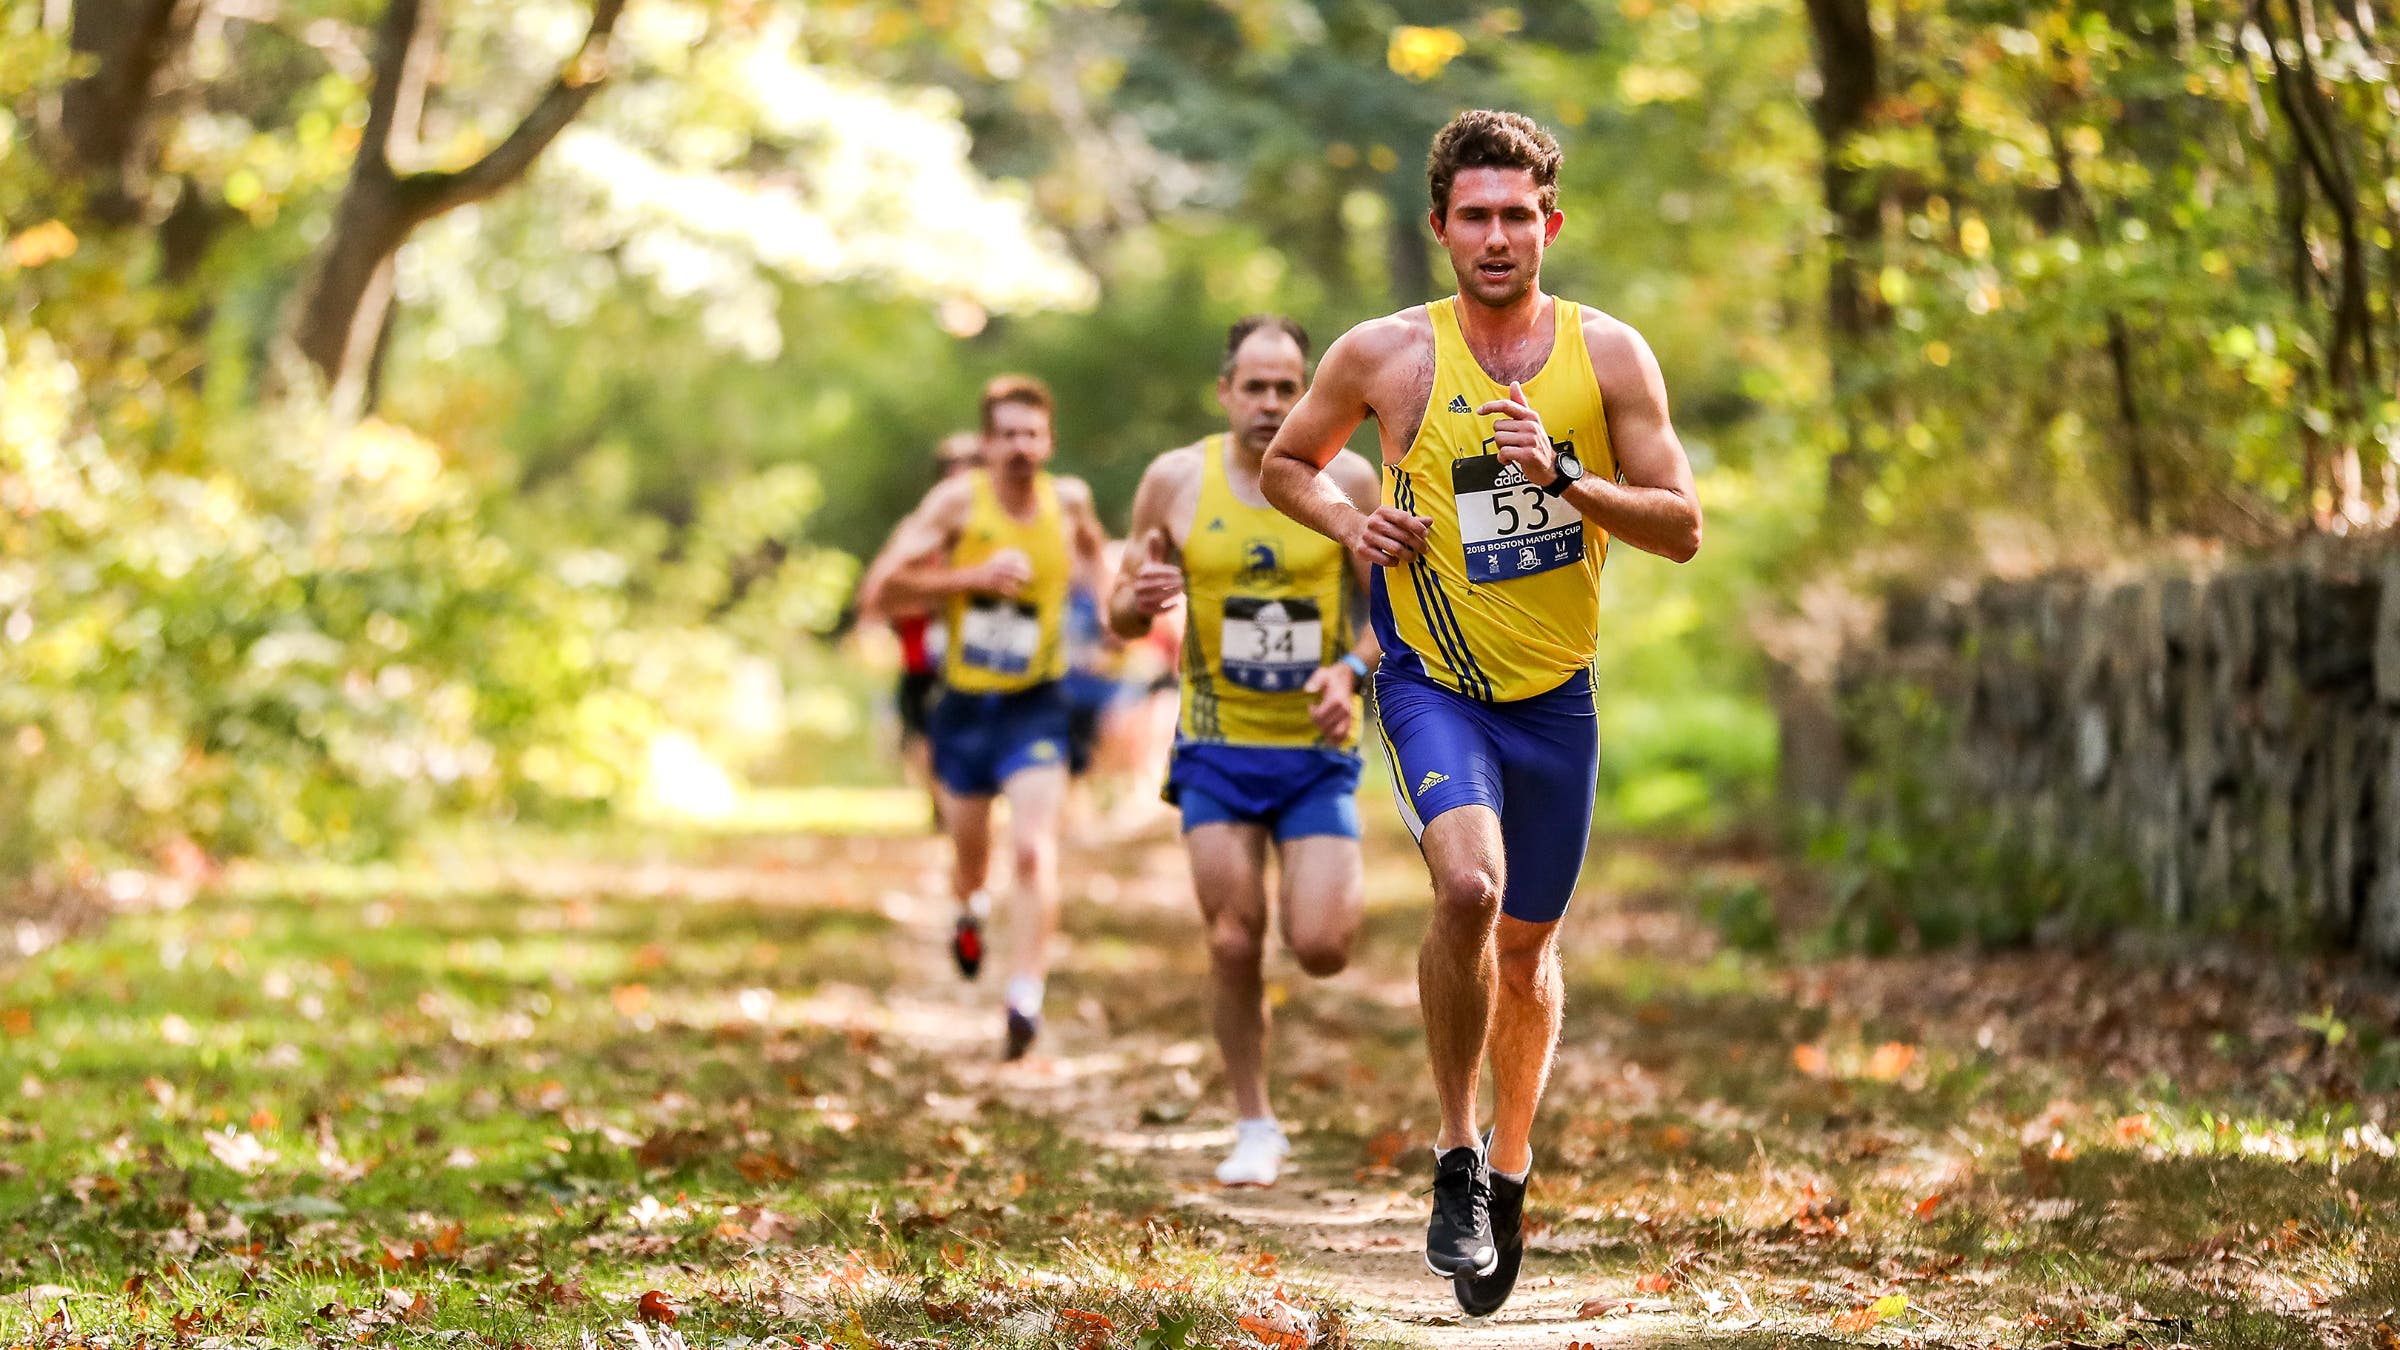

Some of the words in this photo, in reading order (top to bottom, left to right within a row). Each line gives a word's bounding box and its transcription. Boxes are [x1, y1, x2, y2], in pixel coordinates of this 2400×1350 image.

[1492, 486, 1549, 536] 53
[1466, 545, 1486, 555] 2018
[1487, 539, 1525, 552] BOSTON
[1526, 531, 1564, 545] MAYOR'S
[1564, 525, 1581, 536] CUP
[1252, 622, 1293, 662] 34
[1416, 774, 1450, 797] adidas
